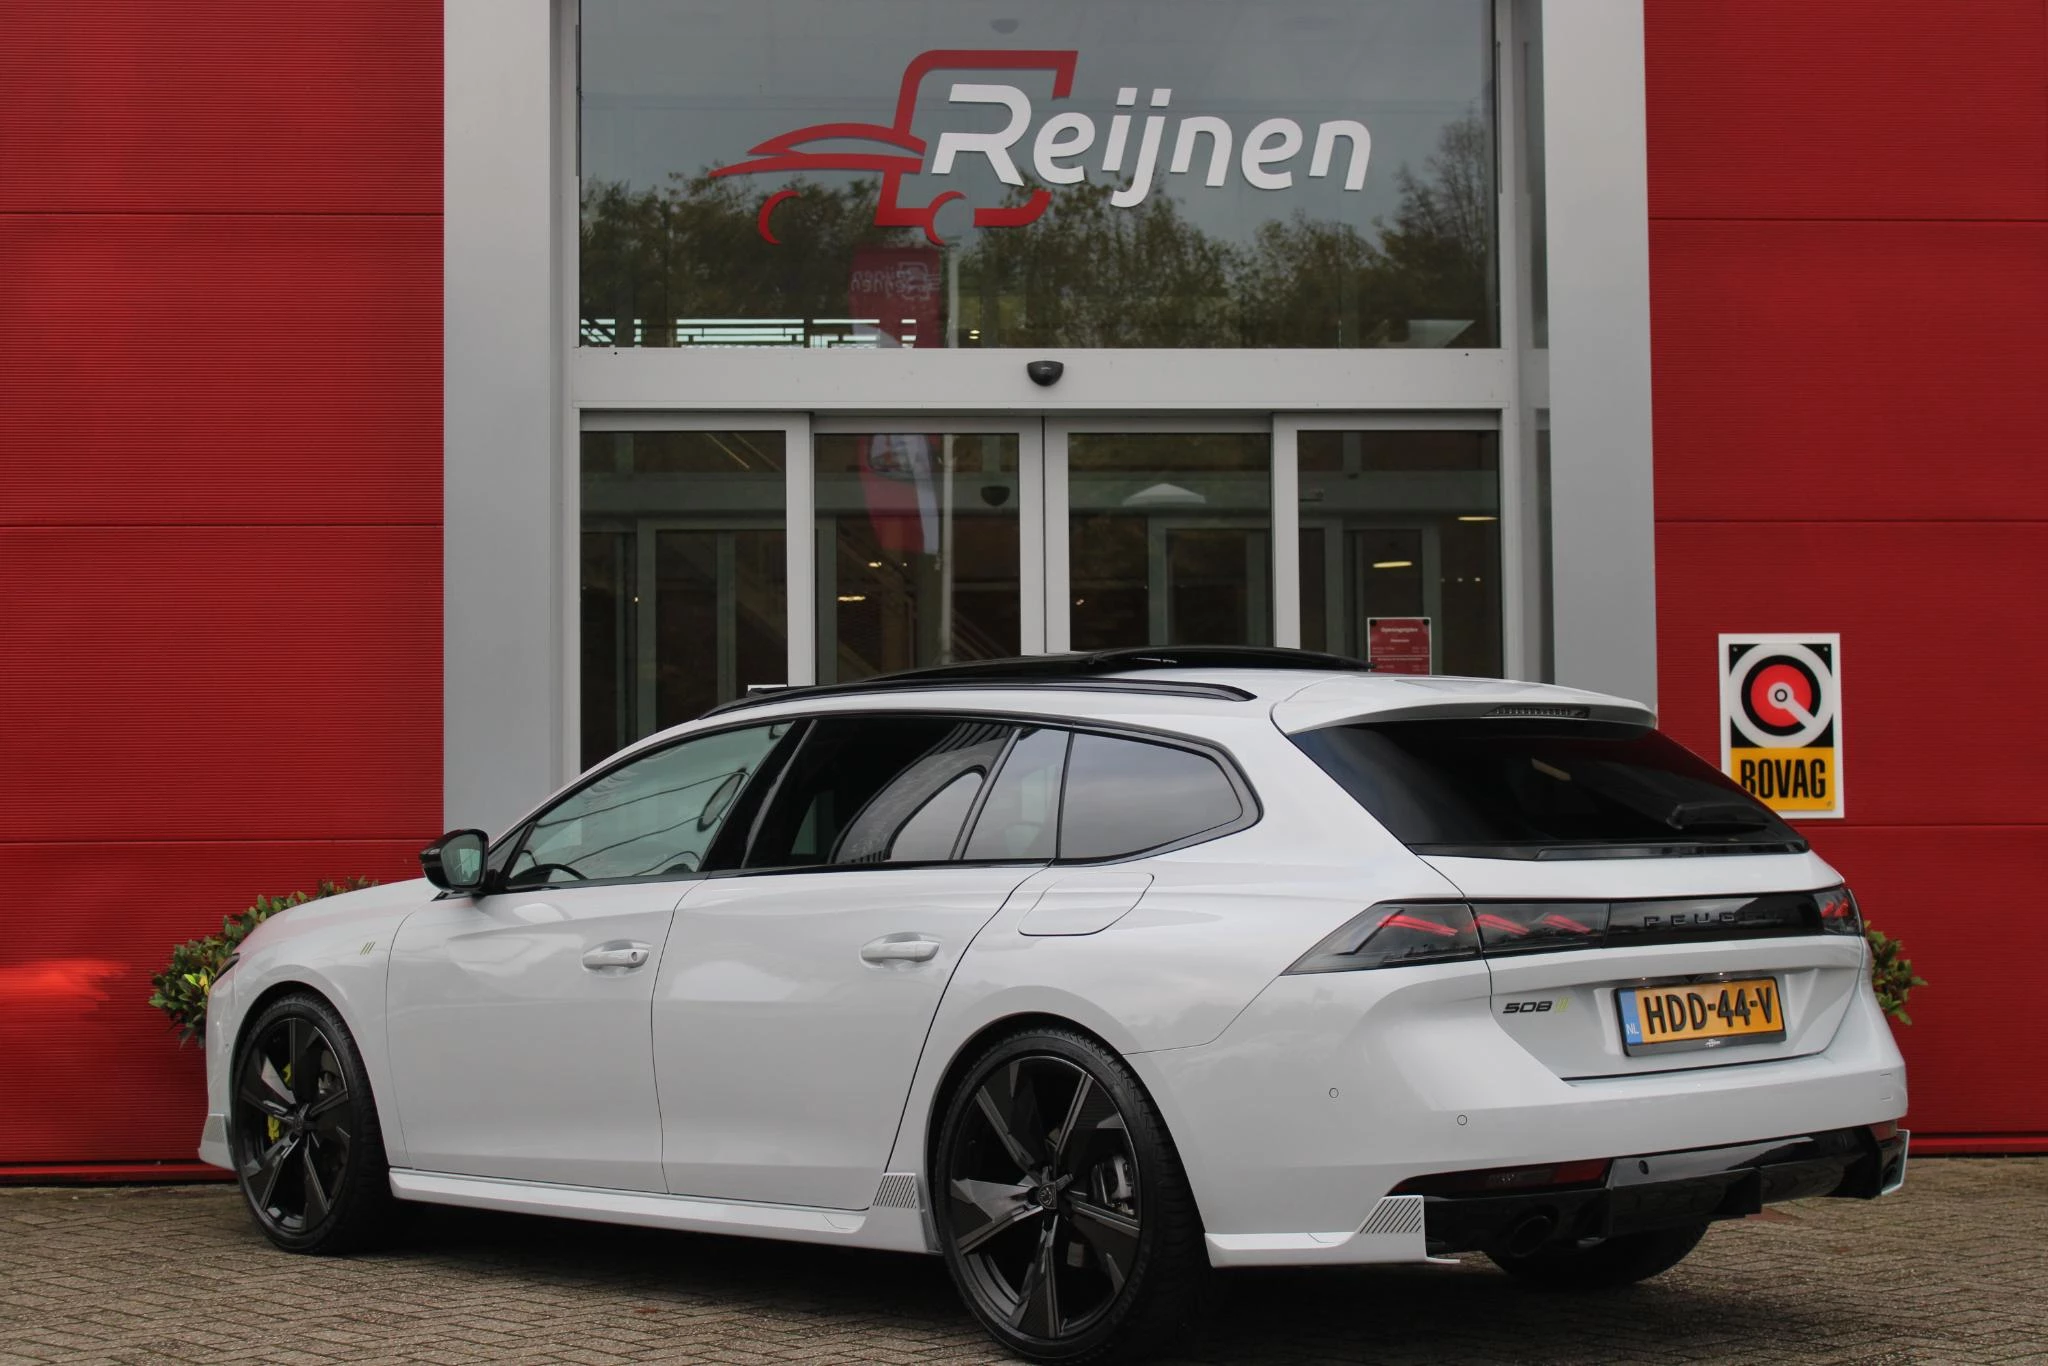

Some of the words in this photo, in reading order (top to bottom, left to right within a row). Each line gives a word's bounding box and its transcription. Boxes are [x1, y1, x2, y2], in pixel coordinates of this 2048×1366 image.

[931, 85, 1371, 208] Reijnen
[1740, 758, 1826, 800] BOVAG
[1502, 1001, 1553, 1014] 508
[1644, 987, 1774, 1035] HDD-44-V
[1626, 1023, 1640, 1036] NL
